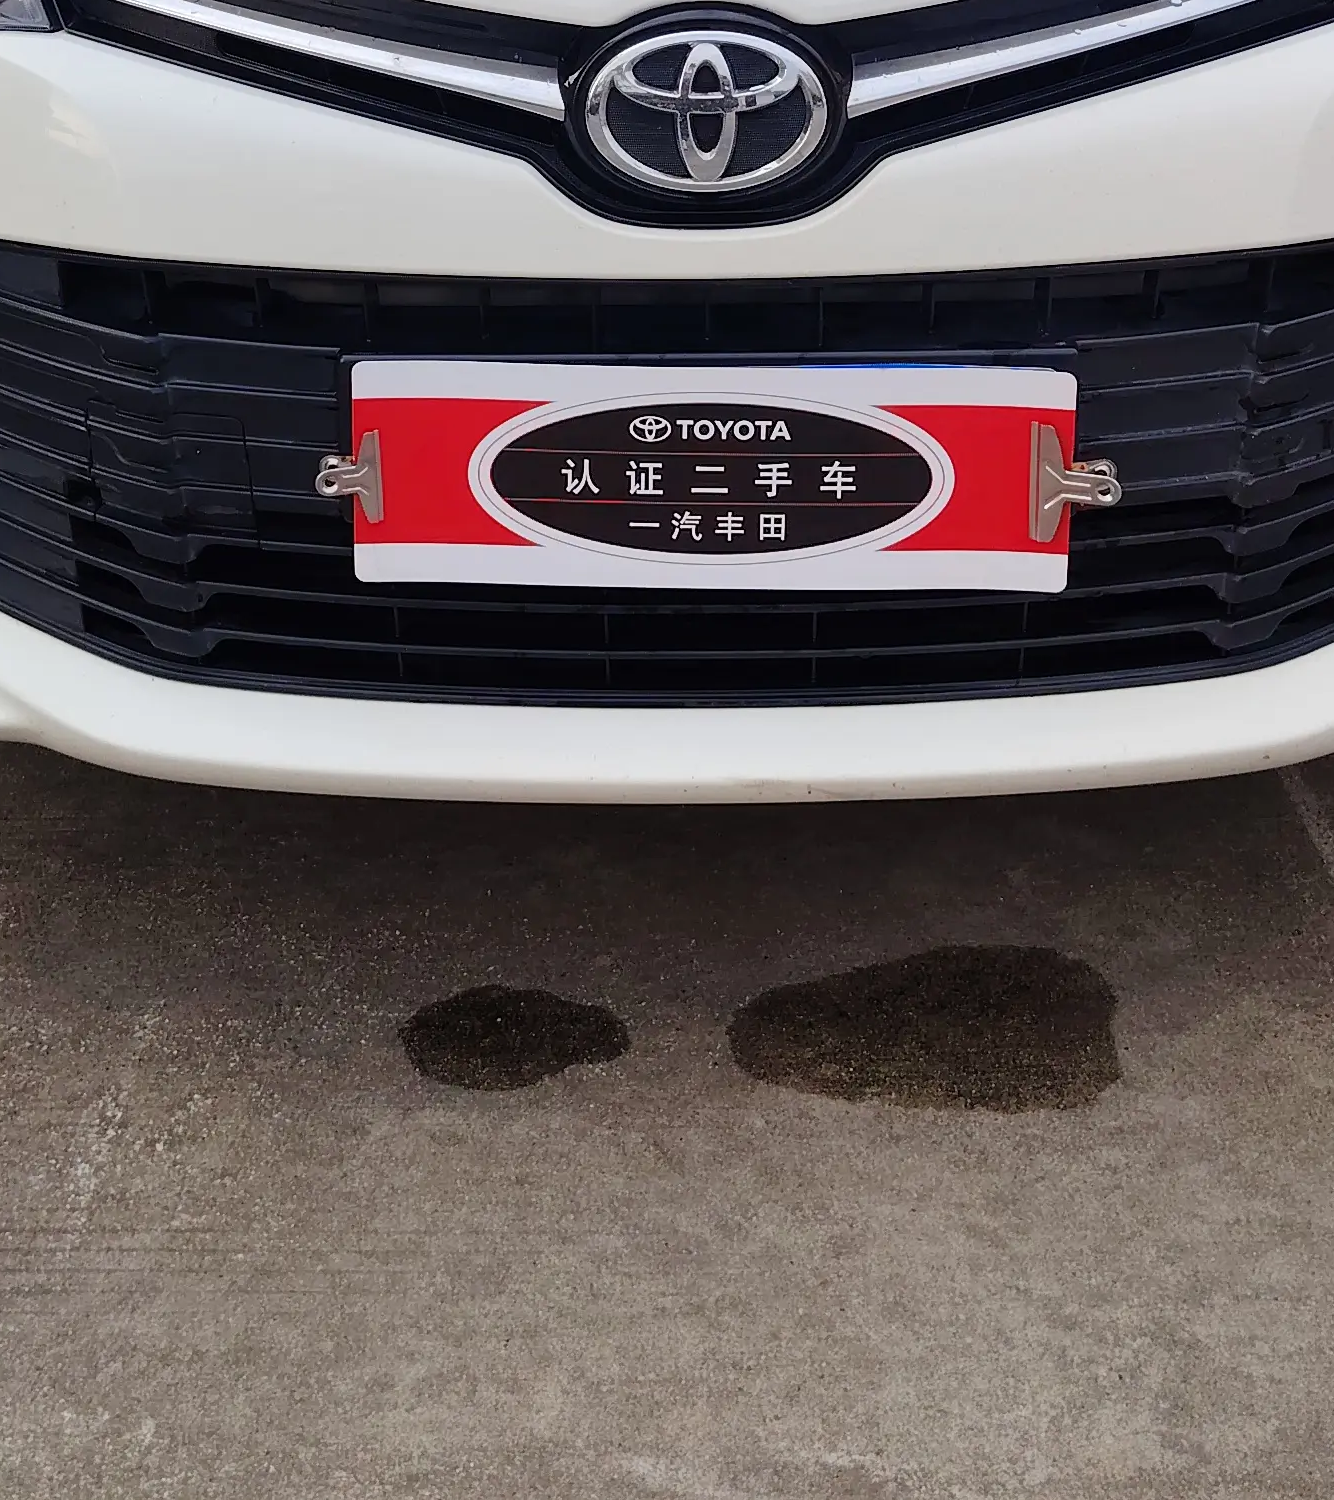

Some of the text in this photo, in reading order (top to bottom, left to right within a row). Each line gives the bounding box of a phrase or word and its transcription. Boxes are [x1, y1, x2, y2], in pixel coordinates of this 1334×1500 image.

[676, 419, 792, 442] TOYOTA
[561, 458, 857, 500] 认证二手车
[628, 510, 787, 542] 一汽丰田
